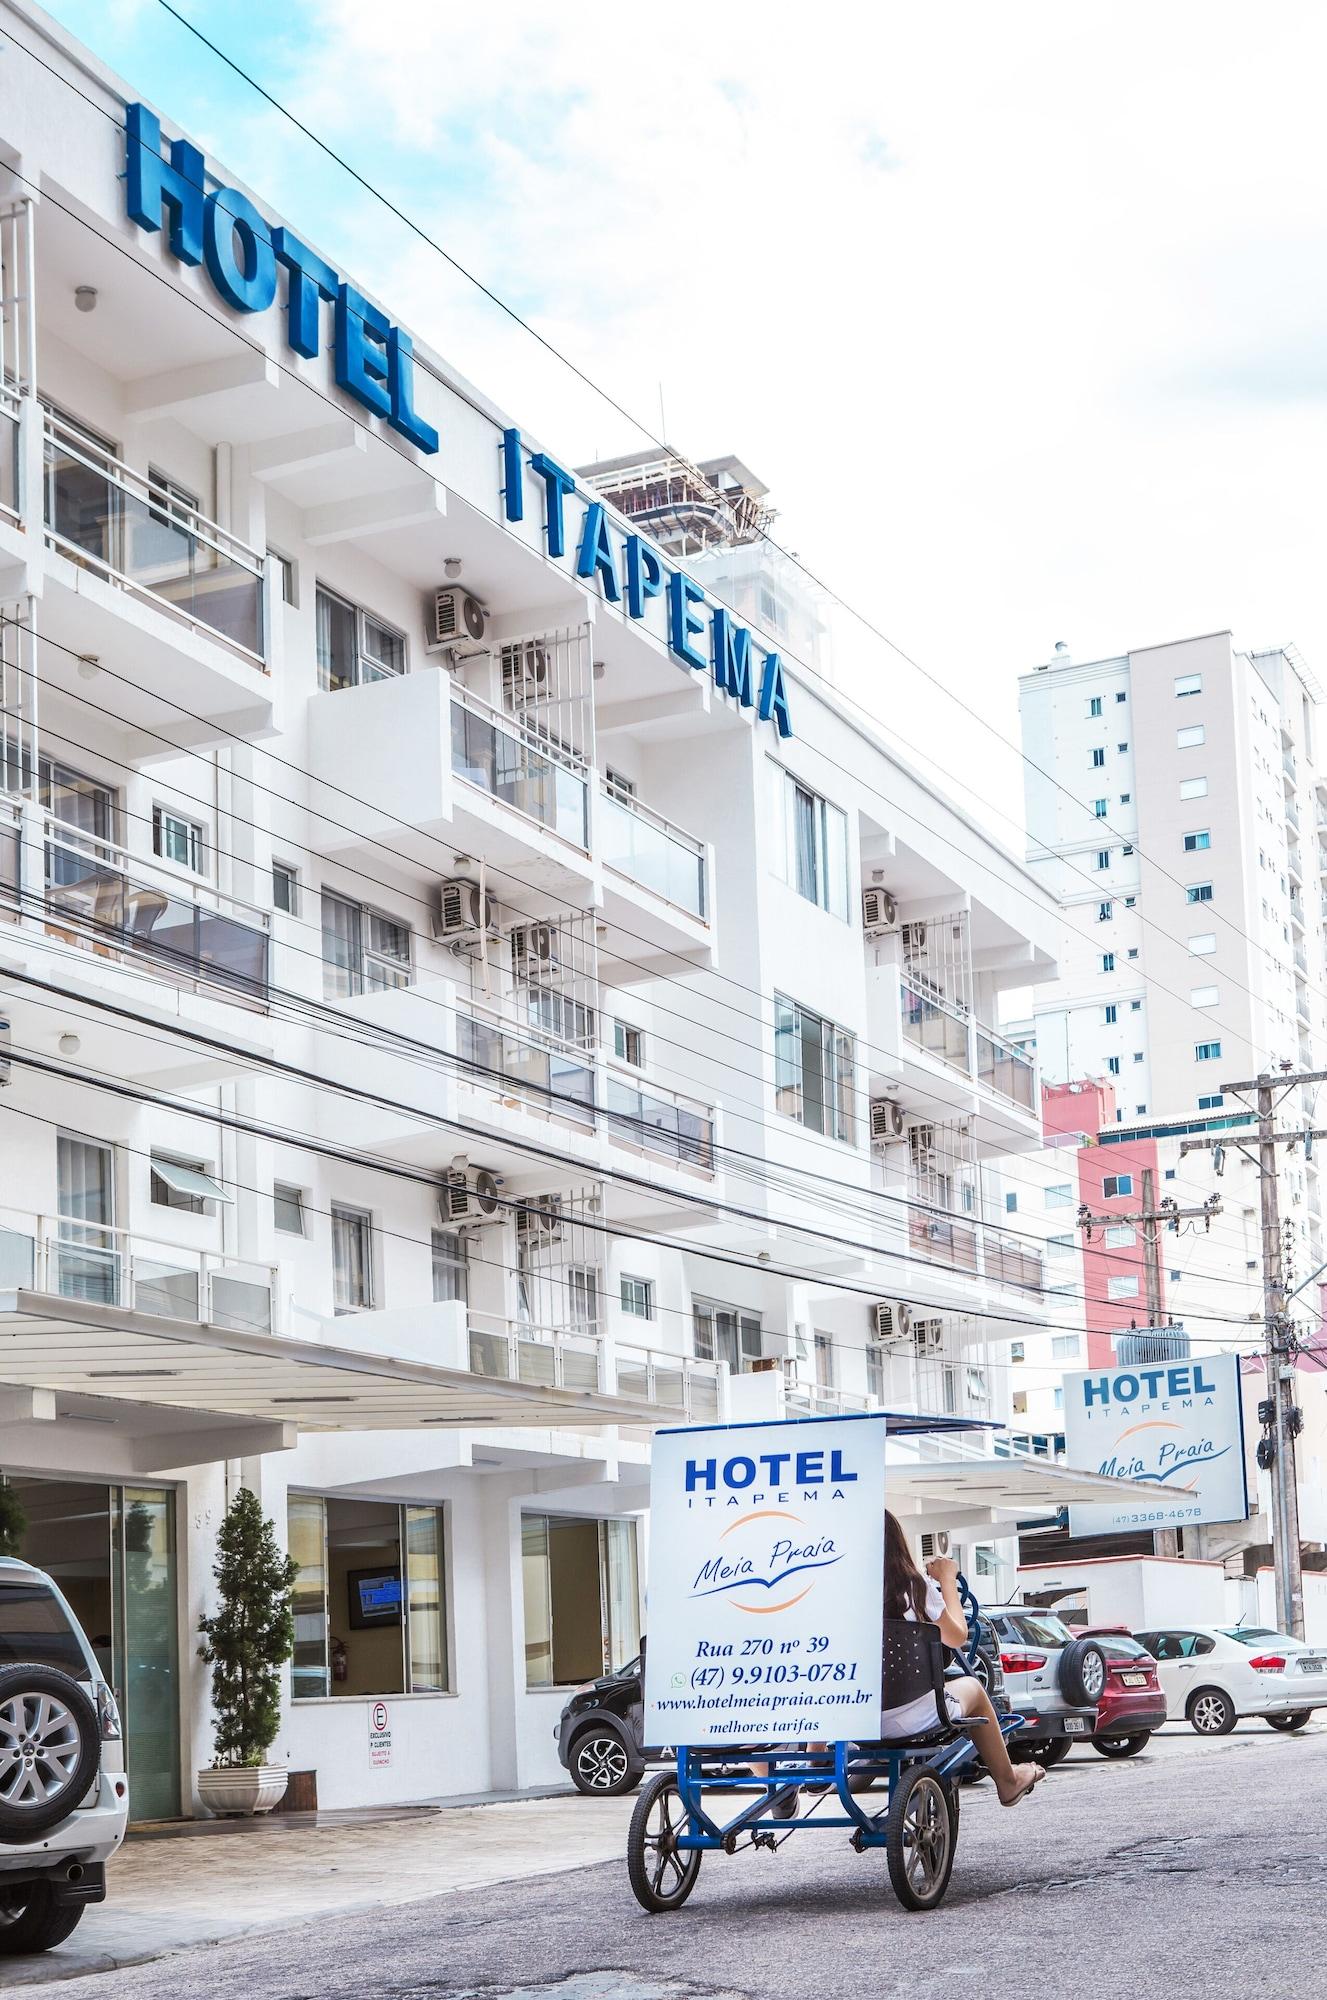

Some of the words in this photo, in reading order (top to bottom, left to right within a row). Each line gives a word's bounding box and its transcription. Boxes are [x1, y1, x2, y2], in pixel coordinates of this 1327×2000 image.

[126, 102, 439, 455] HOTEL
[503, 428, 792, 738] ITAPEMA
[1083, 1365, 1216, 1407] HOTEL
[1087, 1396, 1214, 1419] ITAPEMA
[1098, 1457, 1145, 1478] Meia
[1158, 1438, 1215, 1466] Praia
[685, 1450, 858, 1492] HOTEL
[688, 1489, 845, 1508] ITAPEMA
[693, 1556, 754, 1589] Meia
[769, 1536, 836, 1568] Praia
[695, 1641, 733, 1658] Rua
[740, 1638, 773, 1656] 270
[806, 1636, 830, 1653] 39
[690, 1666, 725, 1690] (47)
[731, 1662, 858, 1686] 9.9103-0781
[657, 1689, 873, 1711] www.hotelmeiapraia.com.br
[376, 1708, 384, 1726] E
[709, 1720, 769, 1734] melhores
[772, 1717, 820, 1735] tarifas
